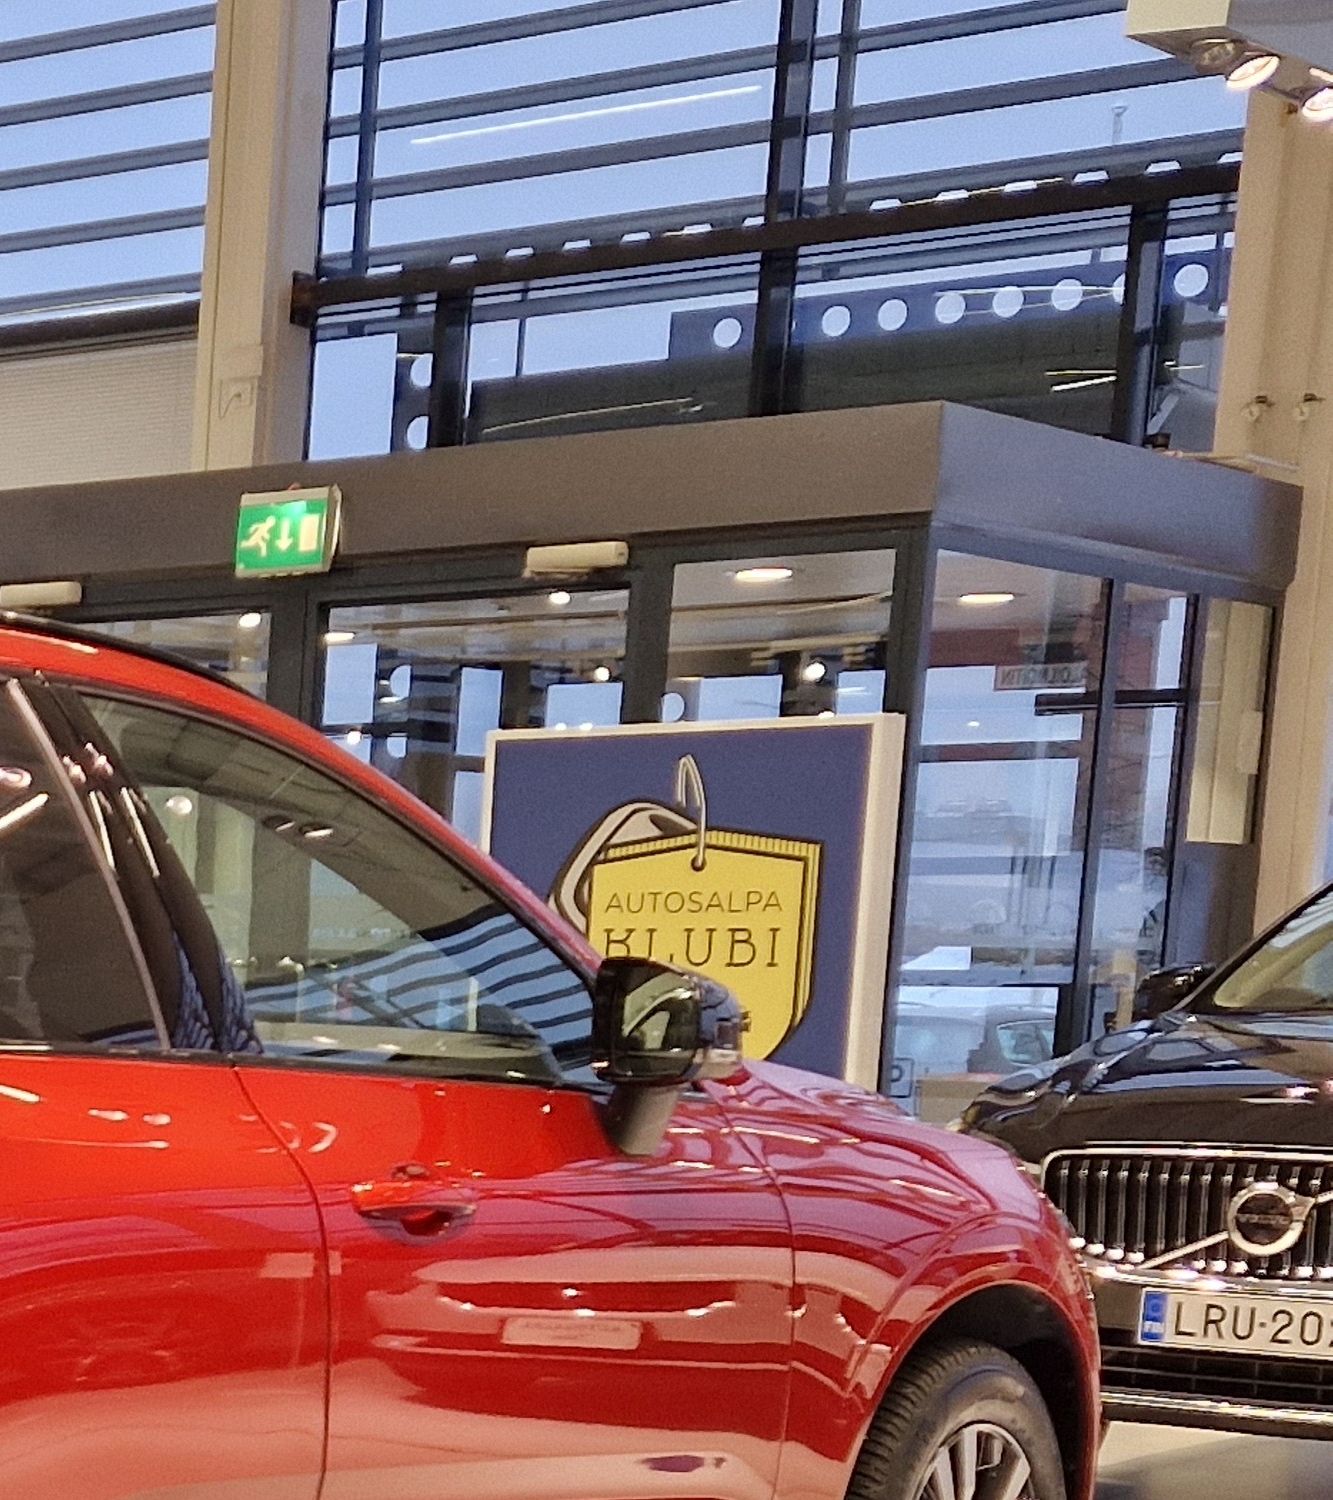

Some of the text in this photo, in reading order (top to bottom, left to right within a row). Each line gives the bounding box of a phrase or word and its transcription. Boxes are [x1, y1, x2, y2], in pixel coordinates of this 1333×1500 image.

[605, 890, 783, 914] AUTOSALPA
[603, 927, 781, 968] KLUBI
[1174, 1301, 1333, 1346] LRU-20
